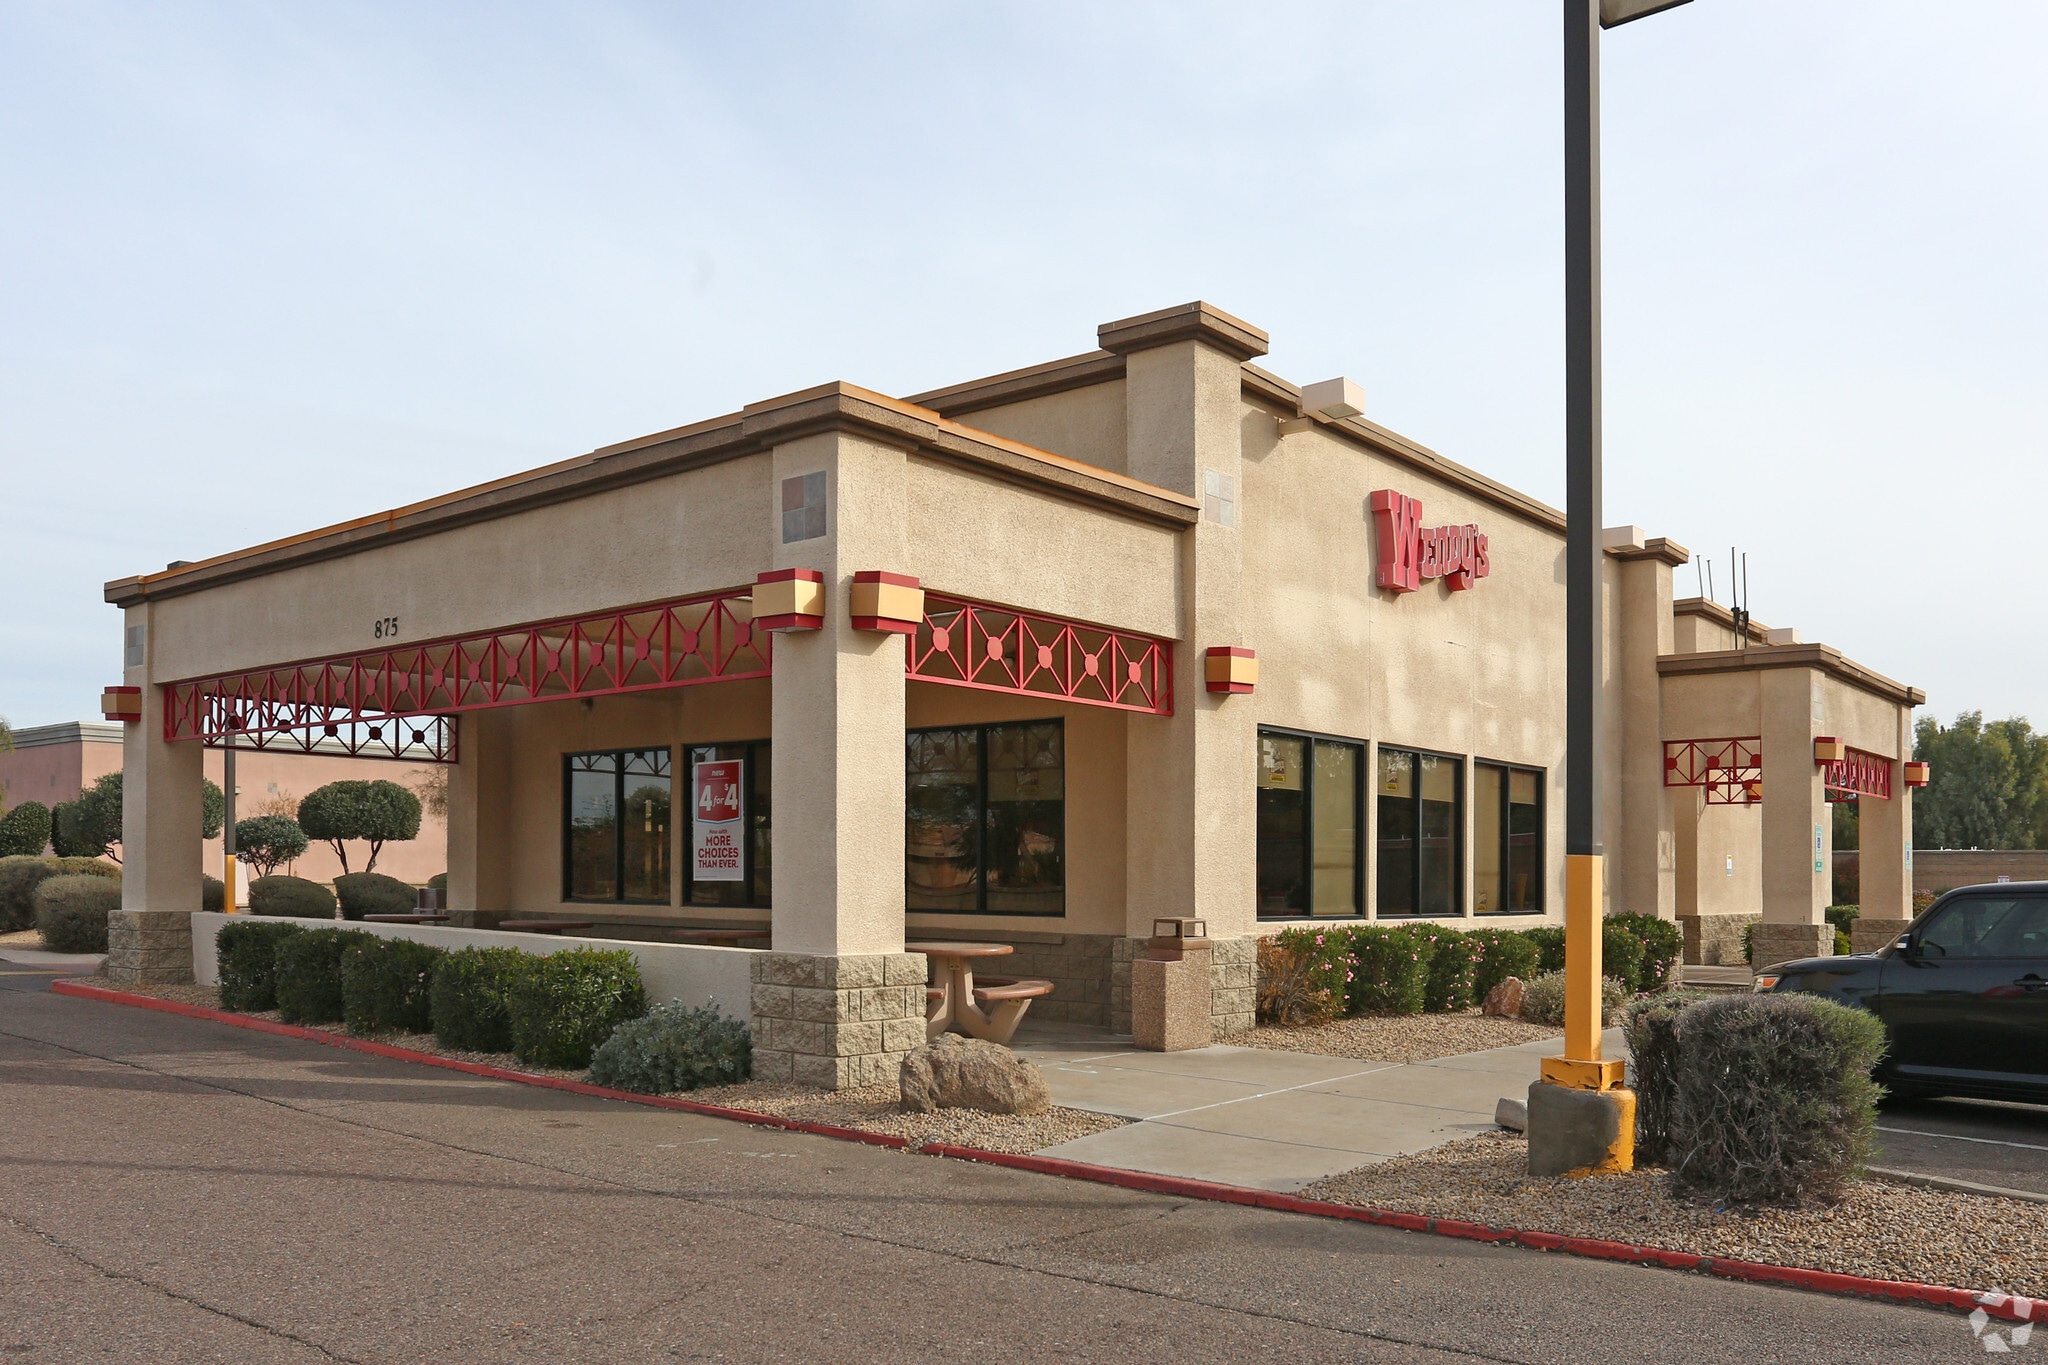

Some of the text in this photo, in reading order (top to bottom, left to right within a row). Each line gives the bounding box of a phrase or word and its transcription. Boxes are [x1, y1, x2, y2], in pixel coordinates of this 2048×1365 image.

[374, 616, 398, 639] 875
[699, 784, 713, 812] 4
[712, 795, 725, 808] for
[705, 835, 731, 846] MORE
[698, 848, 739, 859] CHOICES
[698, 859, 739, 869] THAN EVER.
